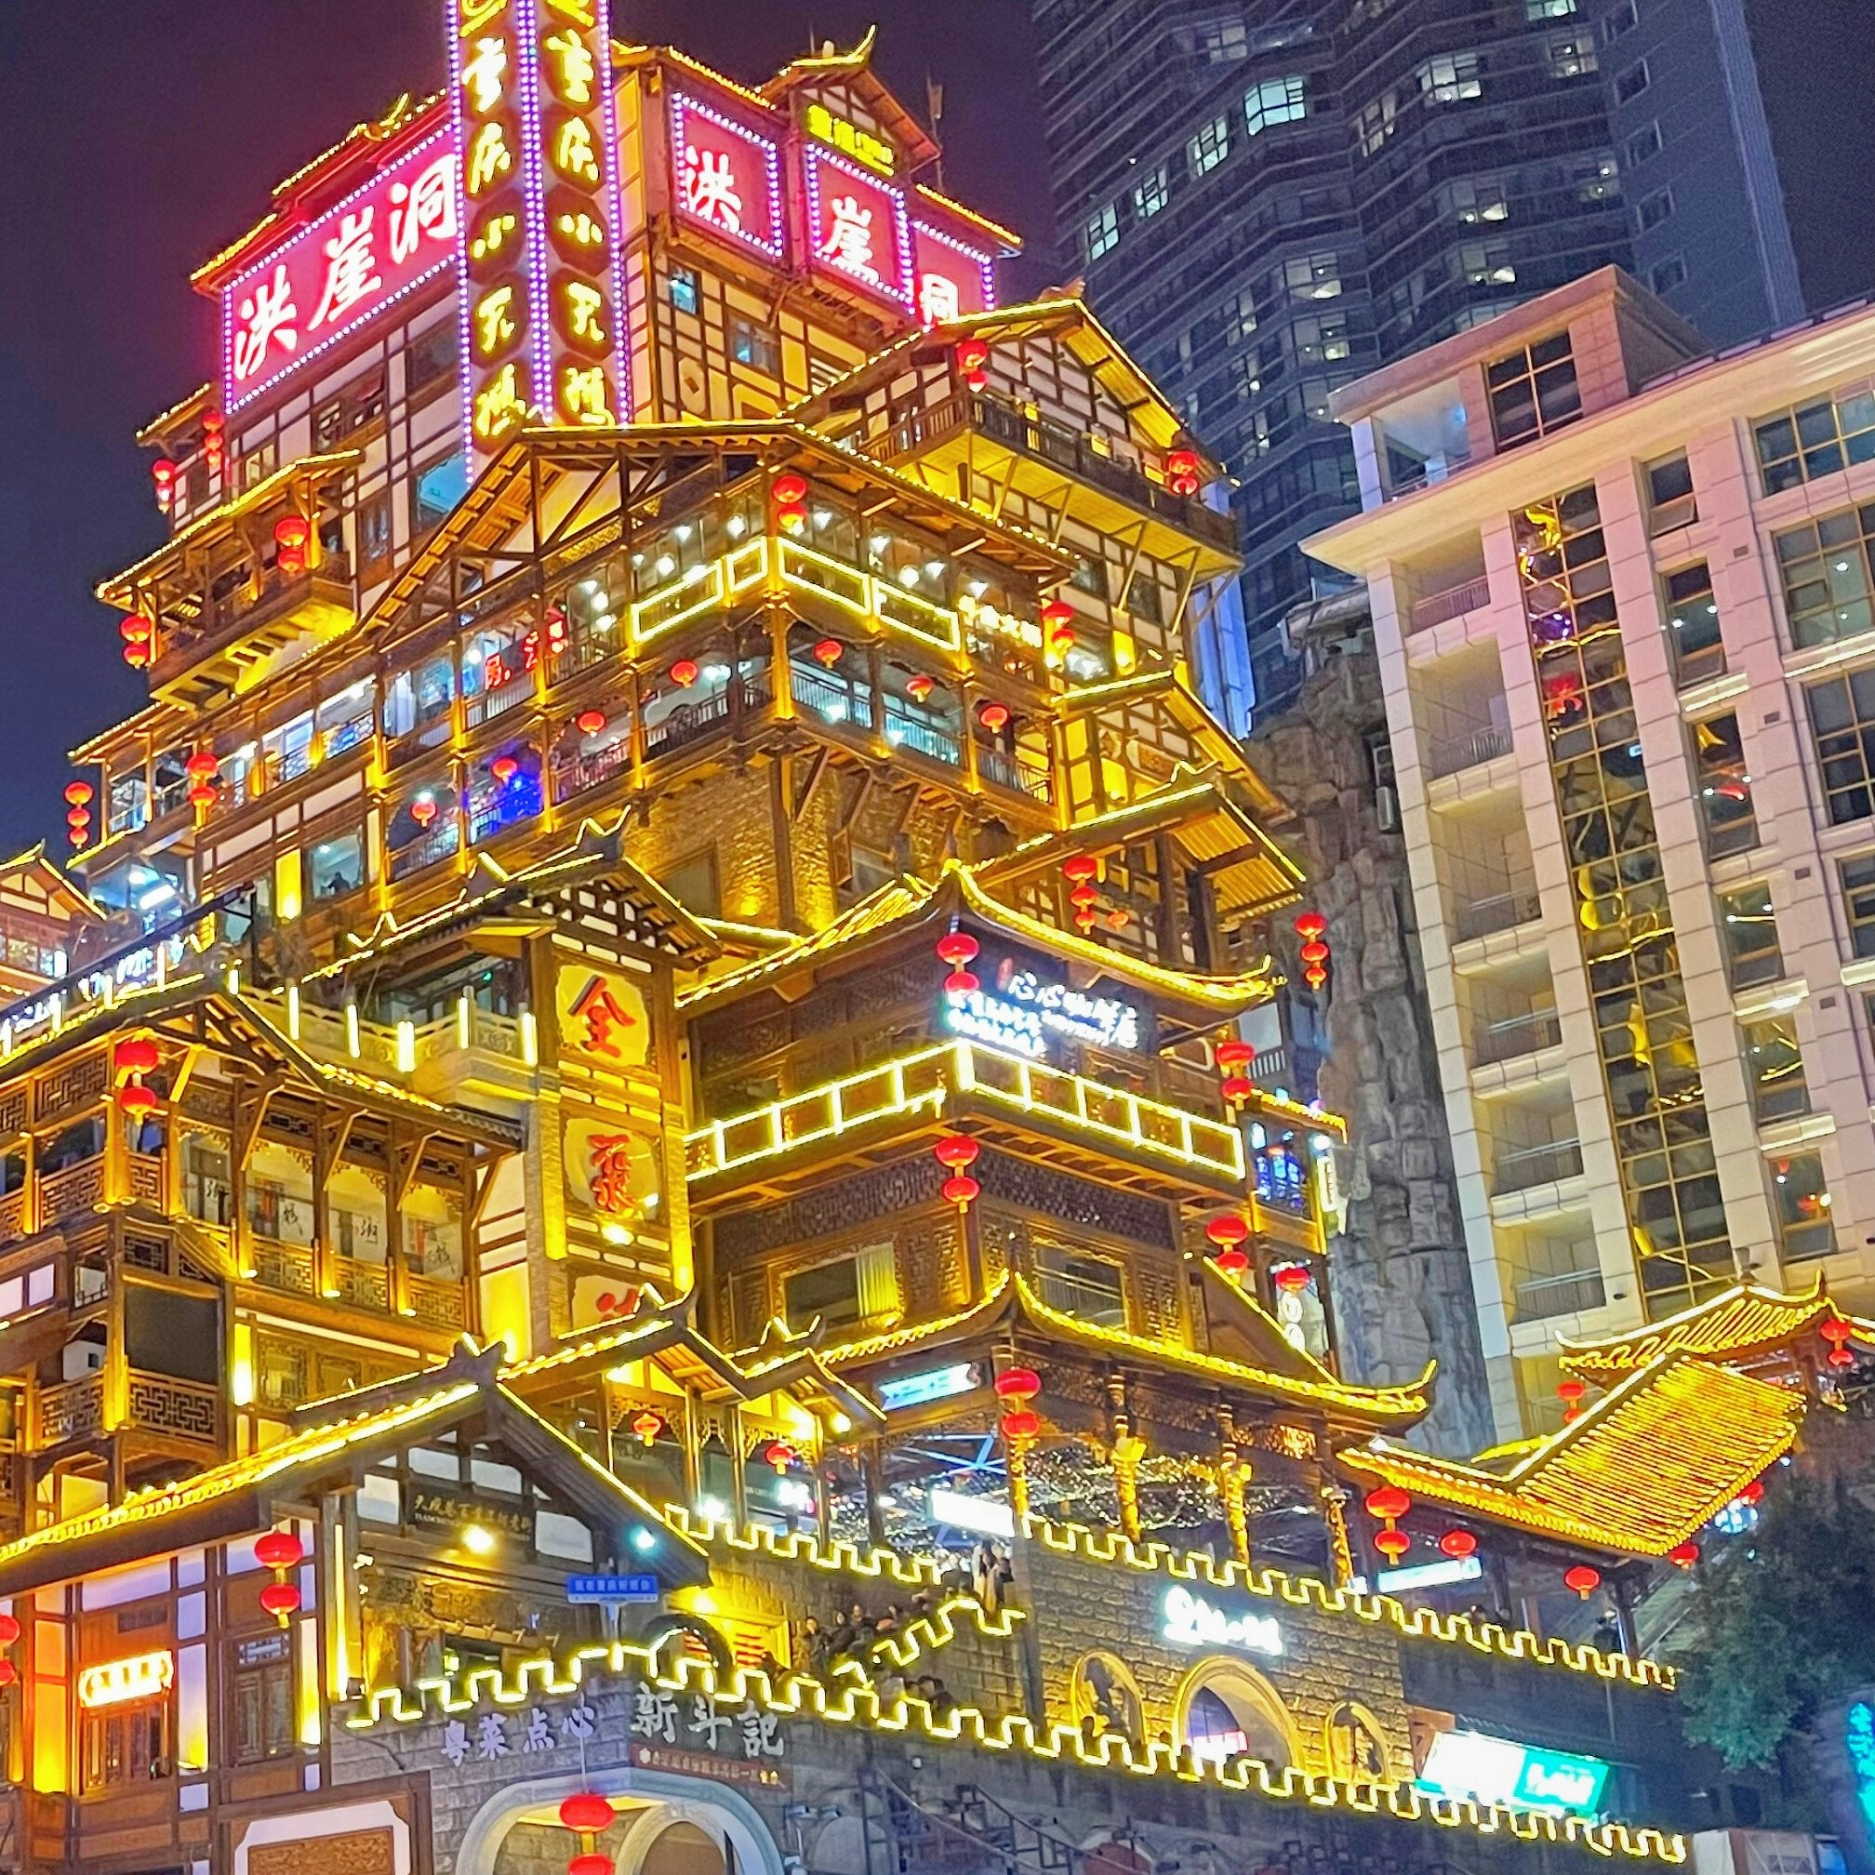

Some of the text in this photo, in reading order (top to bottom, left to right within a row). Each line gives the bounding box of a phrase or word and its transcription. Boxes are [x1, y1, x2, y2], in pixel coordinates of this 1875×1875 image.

[234, 153, 459, 381] 洪崖洞
[440, 1706, 595, 1767] 粤菜点心
[630, 1681, 785, 1758] 新斗記
